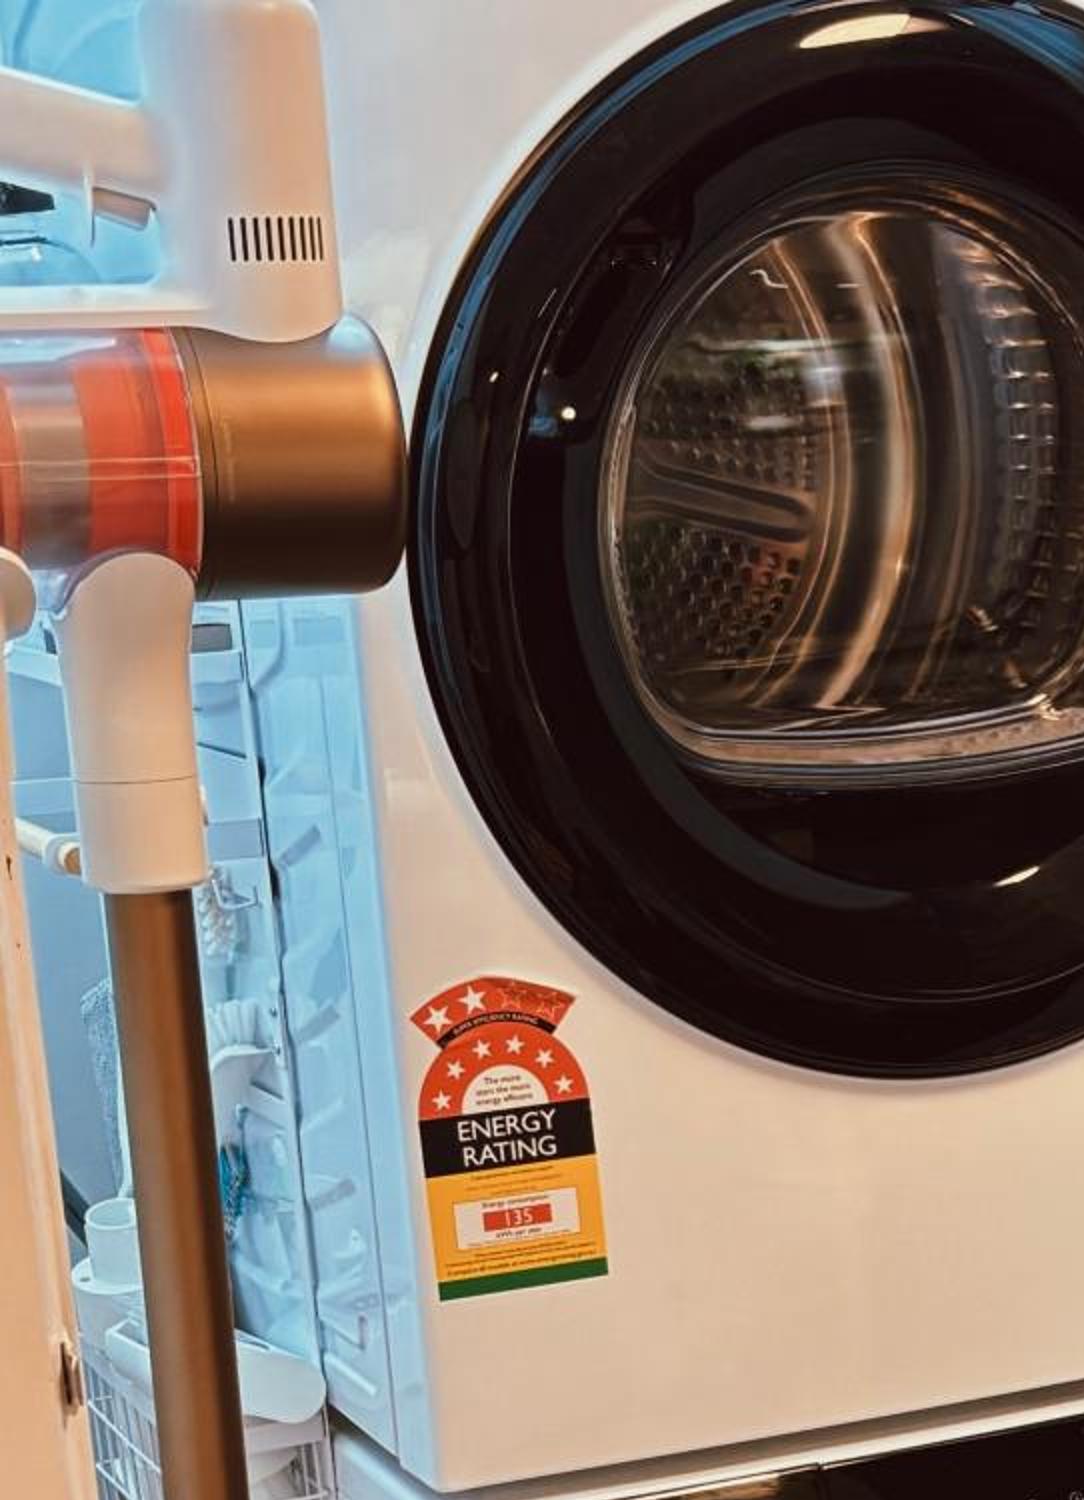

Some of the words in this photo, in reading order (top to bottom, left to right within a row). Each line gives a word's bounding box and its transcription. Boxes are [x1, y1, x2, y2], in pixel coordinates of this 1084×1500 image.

[457, 1109, 557, 1142] ENERGY
[463, 1136, 557, 1167] RATING
[505, 1208, 533, 1227] 135
